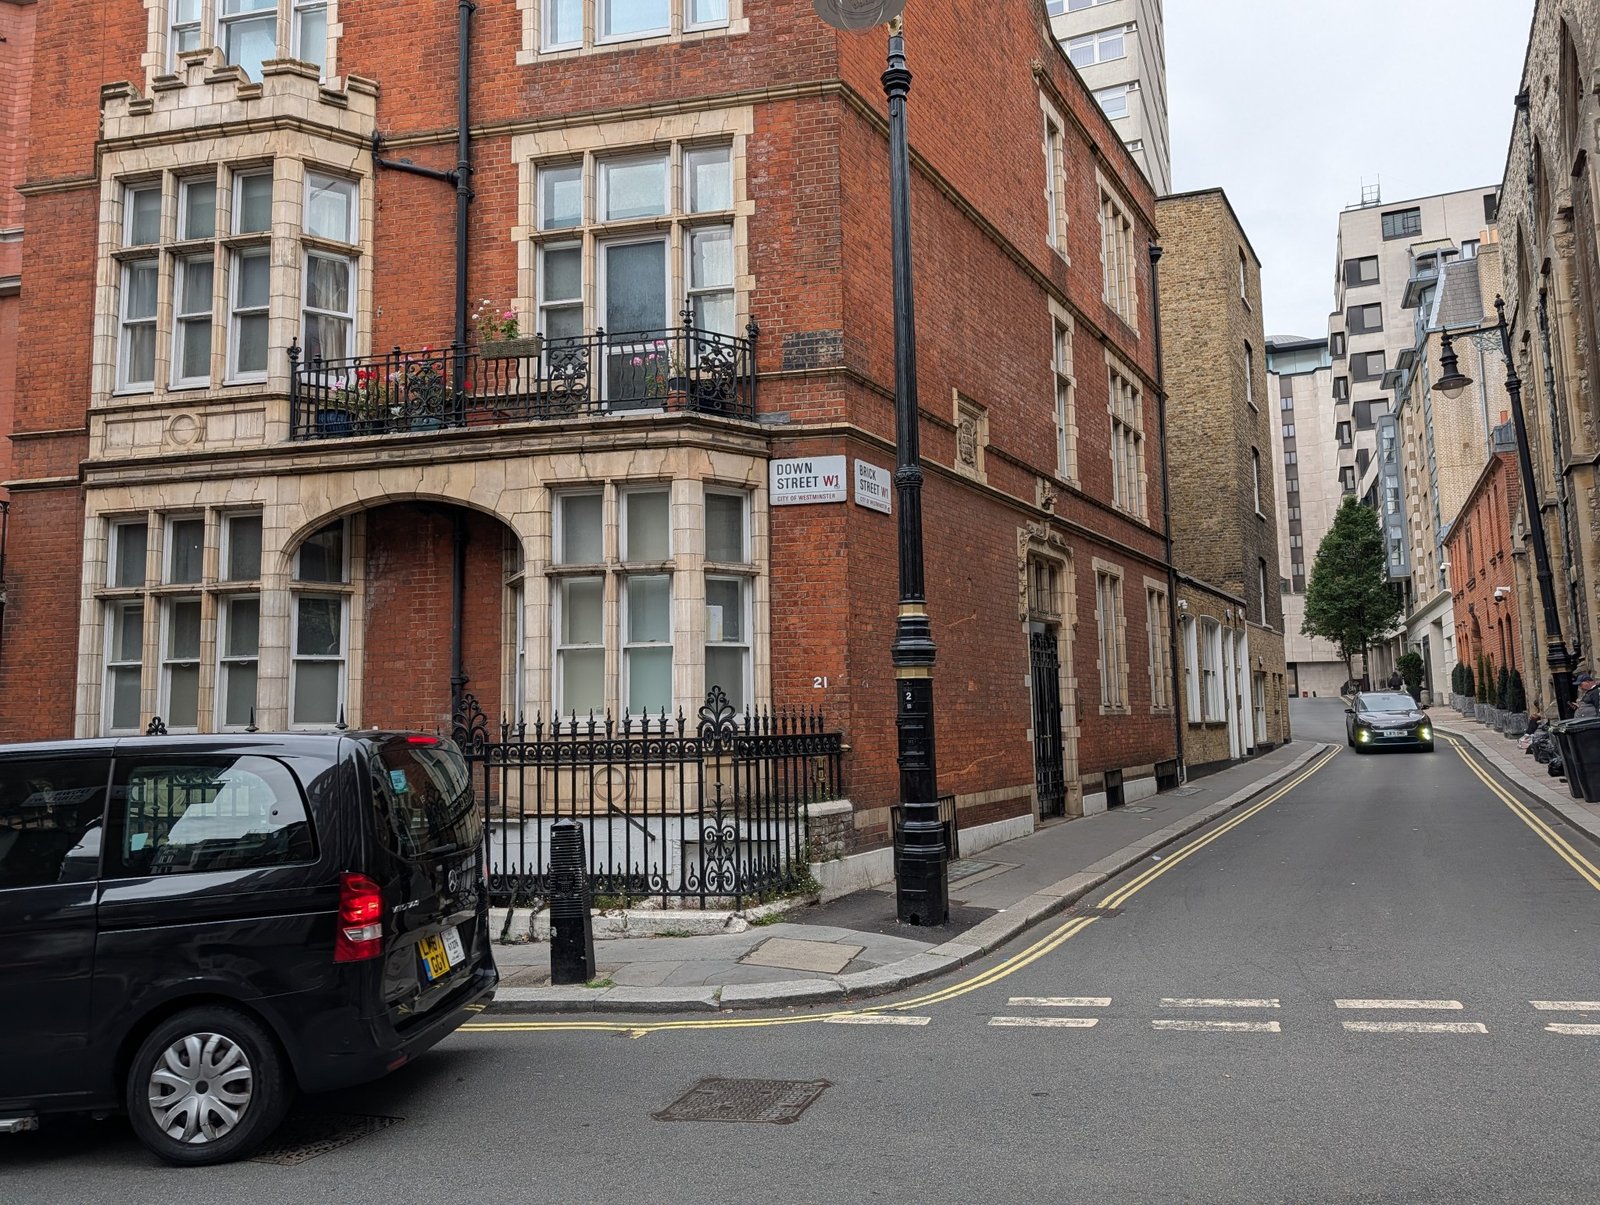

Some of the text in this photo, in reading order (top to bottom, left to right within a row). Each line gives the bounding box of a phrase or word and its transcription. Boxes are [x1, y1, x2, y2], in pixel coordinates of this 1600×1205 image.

[777, 462, 812, 475] DOWN
[859, 464, 876, 481] BRICK
[777, 475, 839, 489] STREET W1
[860, 478, 889, 499] STREET W1
[813, 676, 828, 689] 21
[905, 692, 912, 700] 2
